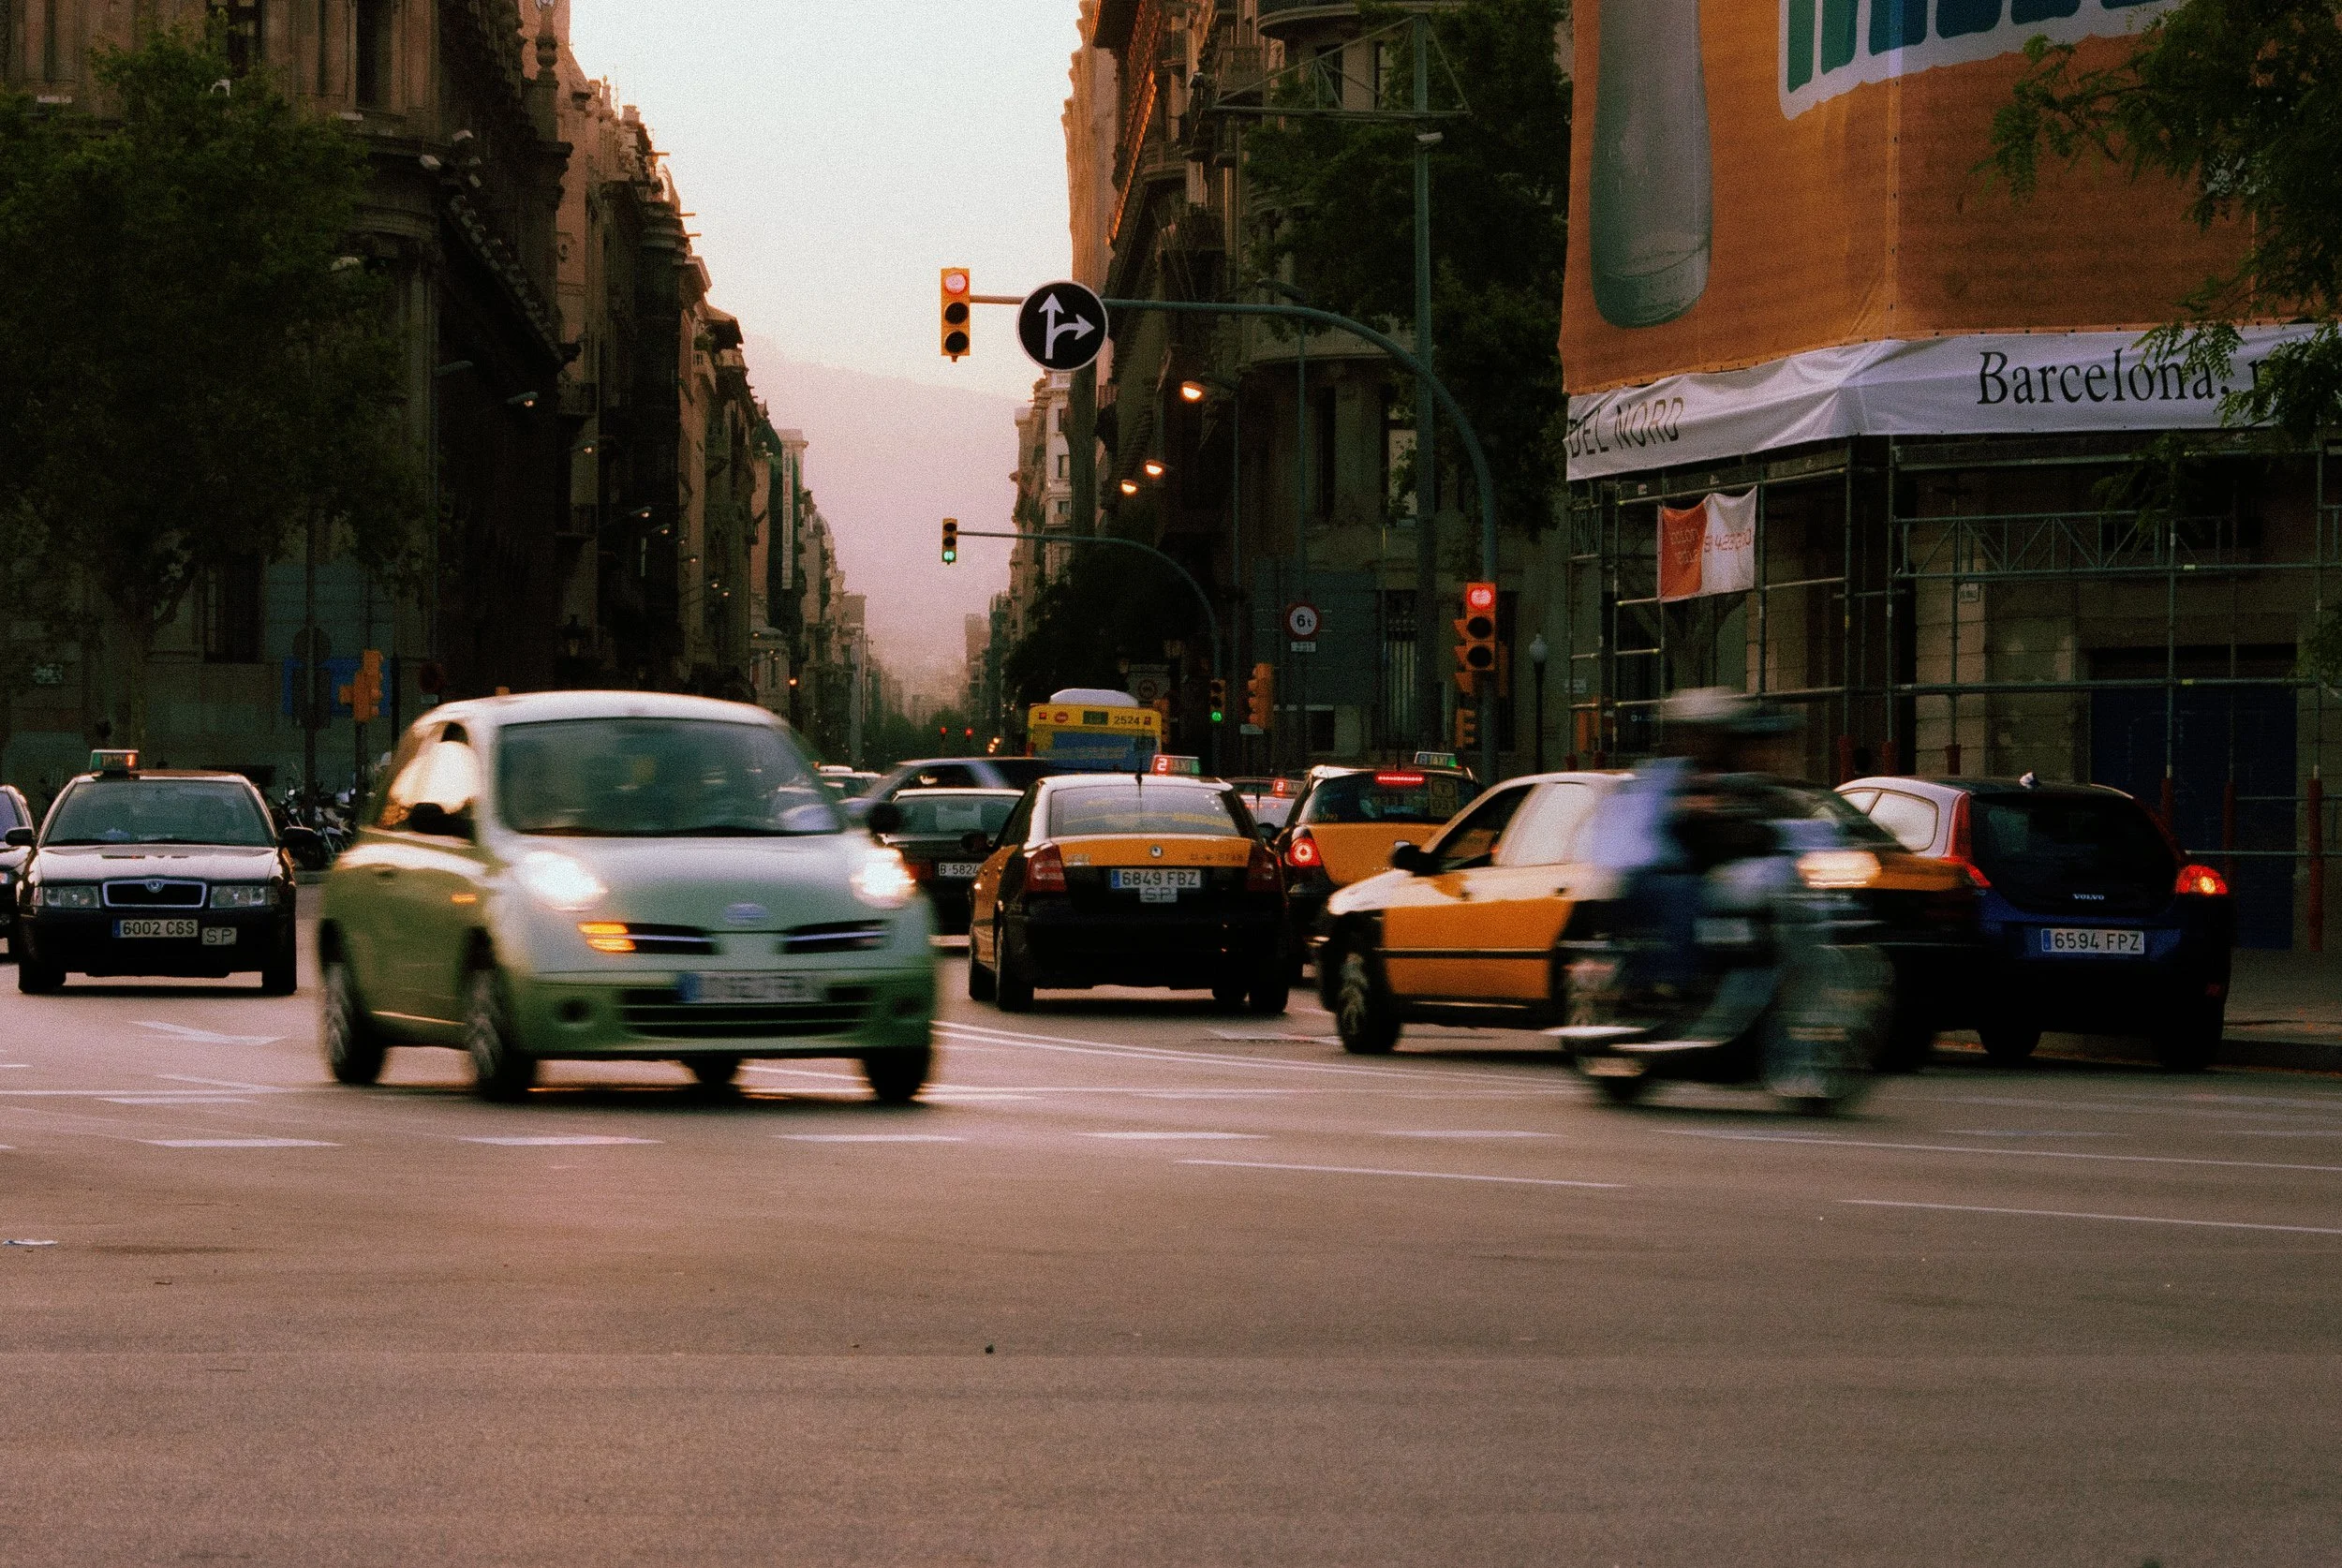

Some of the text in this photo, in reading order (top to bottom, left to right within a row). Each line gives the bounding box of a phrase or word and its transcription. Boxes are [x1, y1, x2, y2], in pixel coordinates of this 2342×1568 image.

[1568, 396, 1684, 458] DEL NORD
[1114, 715, 1139, 725] 2524
[1157, 757, 1167, 771] 2
[1121, 871, 1197, 885] 6849 FBZ
[1145, 887, 1172, 901] SP
[2072, 893, 2105, 901] VOLVO
[123, 921, 161, 936] 6002
[206, 928, 233, 944] SP
[2054, 931, 2140, 952] 6594 FPZ
